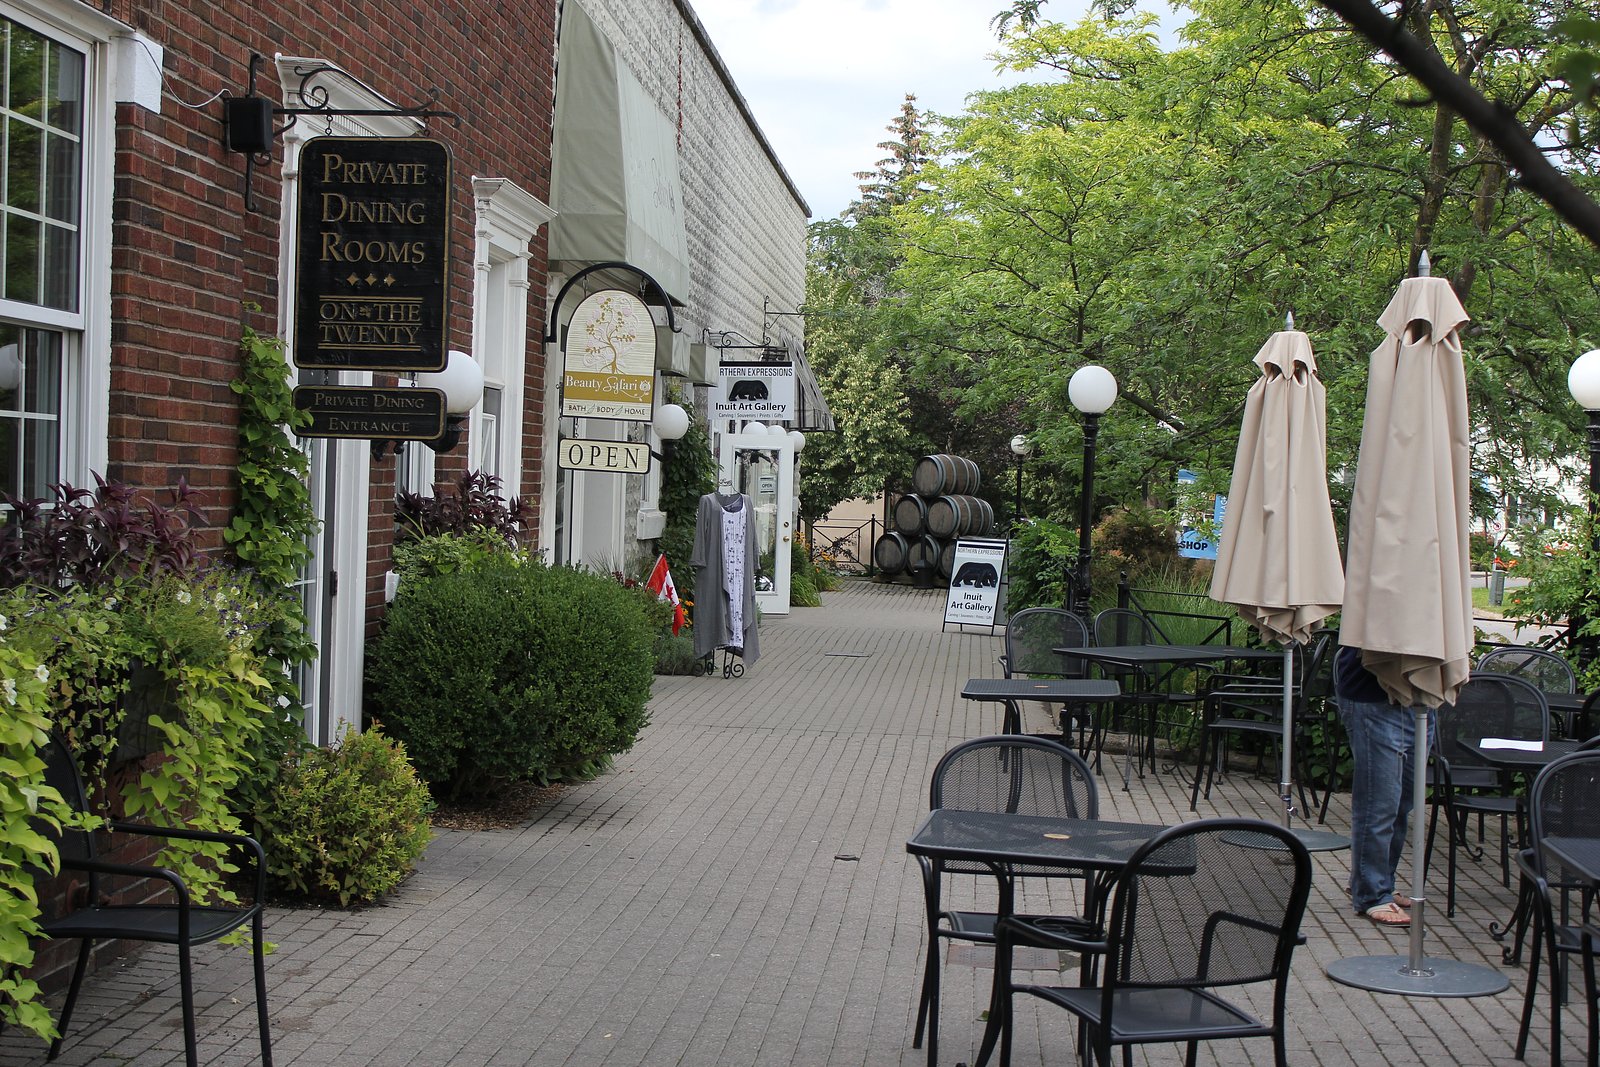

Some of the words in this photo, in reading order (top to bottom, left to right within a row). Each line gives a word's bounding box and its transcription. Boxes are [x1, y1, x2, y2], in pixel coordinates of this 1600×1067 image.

[321, 153, 429, 185] PRIVATE
[320, 192, 426, 225] DINING
[320, 232, 425, 264] ROOMS
[319, 302, 357, 320] ON
[373, 303, 421, 322] THE
[319, 324, 421, 344] TWENTY
[747, 367, 793, 377] EXPRESSIONS
[566, 375, 602, 391] Beauty
[602, 376, 638, 394] Safari
[314, 392, 369, 407] PRIVATE
[373, 394, 425, 409] DINING
[715, 402, 737, 411] Inuit
[738, 402, 753, 411] Art
[754, 402, 787, 413] Gallery
[624, 407, 646, 415] HOME
[328, 417, 411, 432] ENTRANCE
[568, 443, 640, 469] OPEN
[1179, 540, 1208, 551] SHOP
[964, 592, 982, 600] Inuit
[951, 601, 963, 609] Art
[964, 602, 993, 613] Gallery
